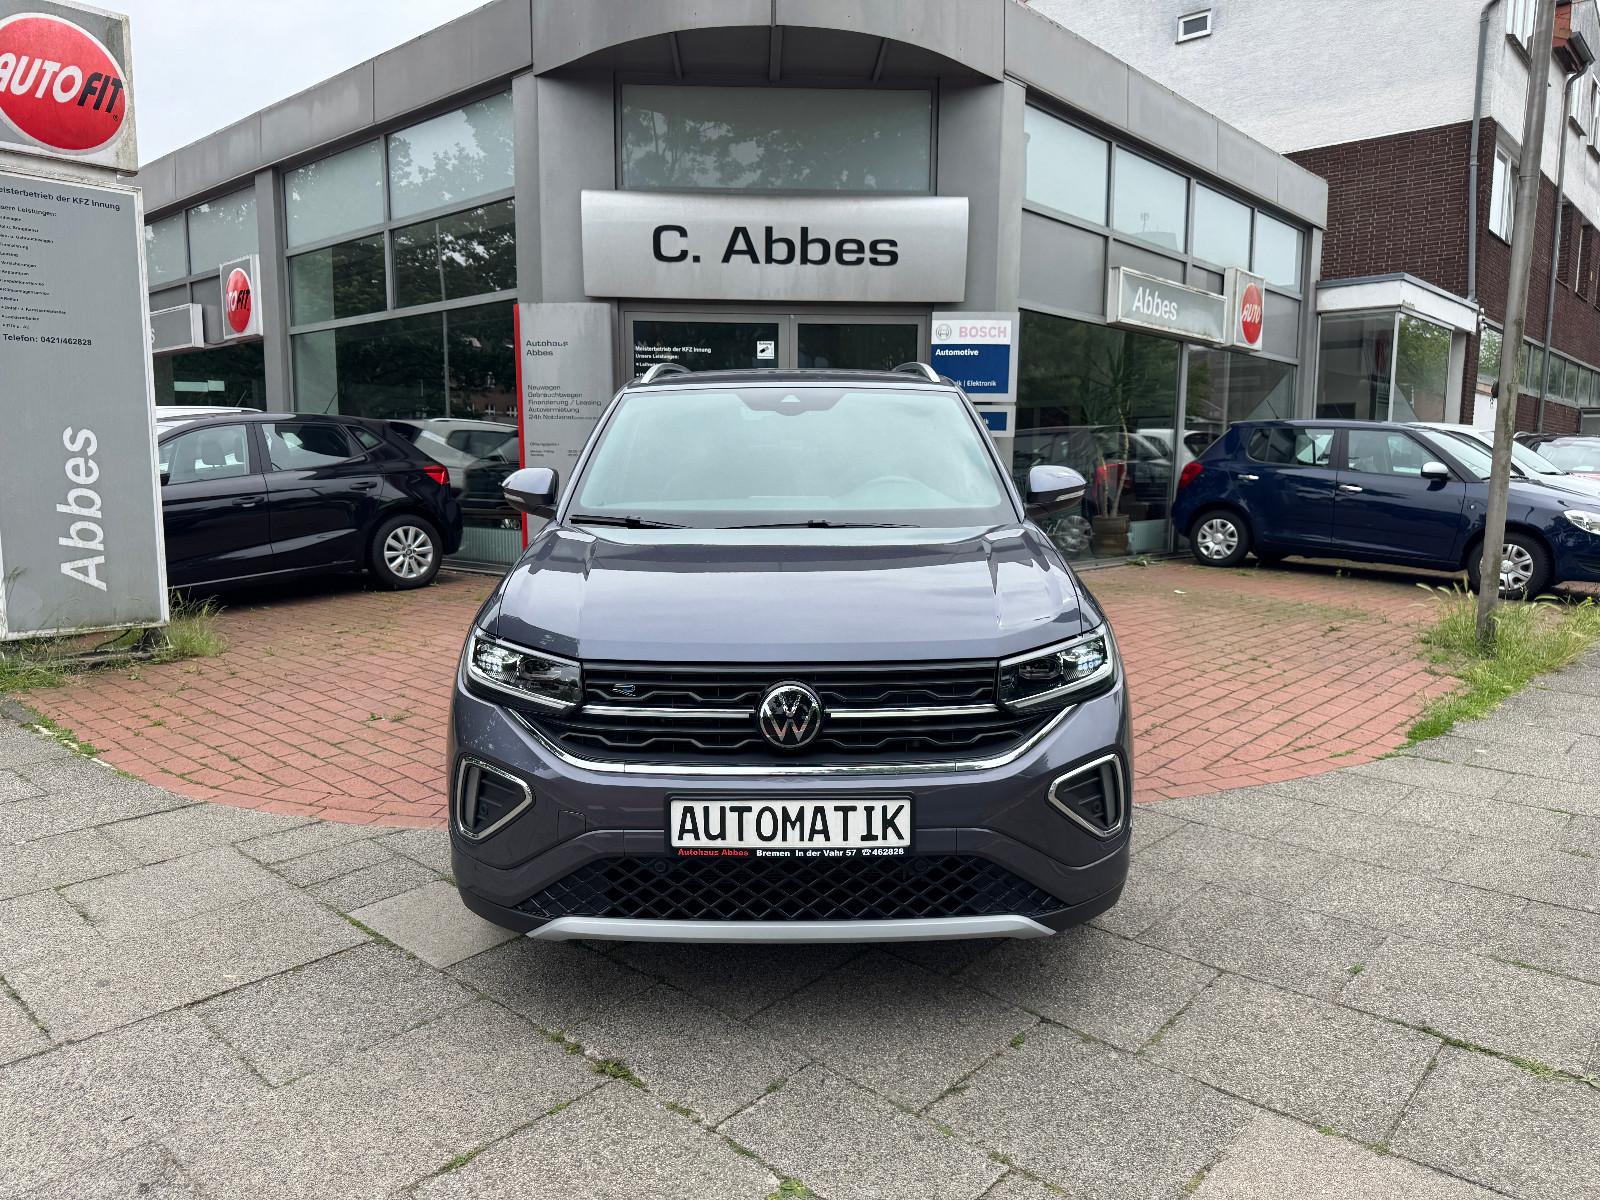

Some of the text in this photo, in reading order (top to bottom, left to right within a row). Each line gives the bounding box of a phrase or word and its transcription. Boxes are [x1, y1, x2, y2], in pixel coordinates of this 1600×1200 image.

[0, 53, 124, 113] AUTOFIT
[56, 194, 70, 202] der
[72, 197, 90, 206] KFZ
[91, 199, 121, 212] Innung
[652, 224, 899, 267] C. Abbes
[1132, 286, 1178, 321] Abbes
[3, 333, 92, 347] Telefon: 0421/462828
[959, 326, 1007, 338] BOSCH
[935, 348, 979, 356] Automotive
[56, 426, 107, 592] Abbes
[677, 805, 905, 842] AUTOMATIK
[678, 848, 904, 857] Autohaus Abbes Bremen In der Vahr 57 462828
